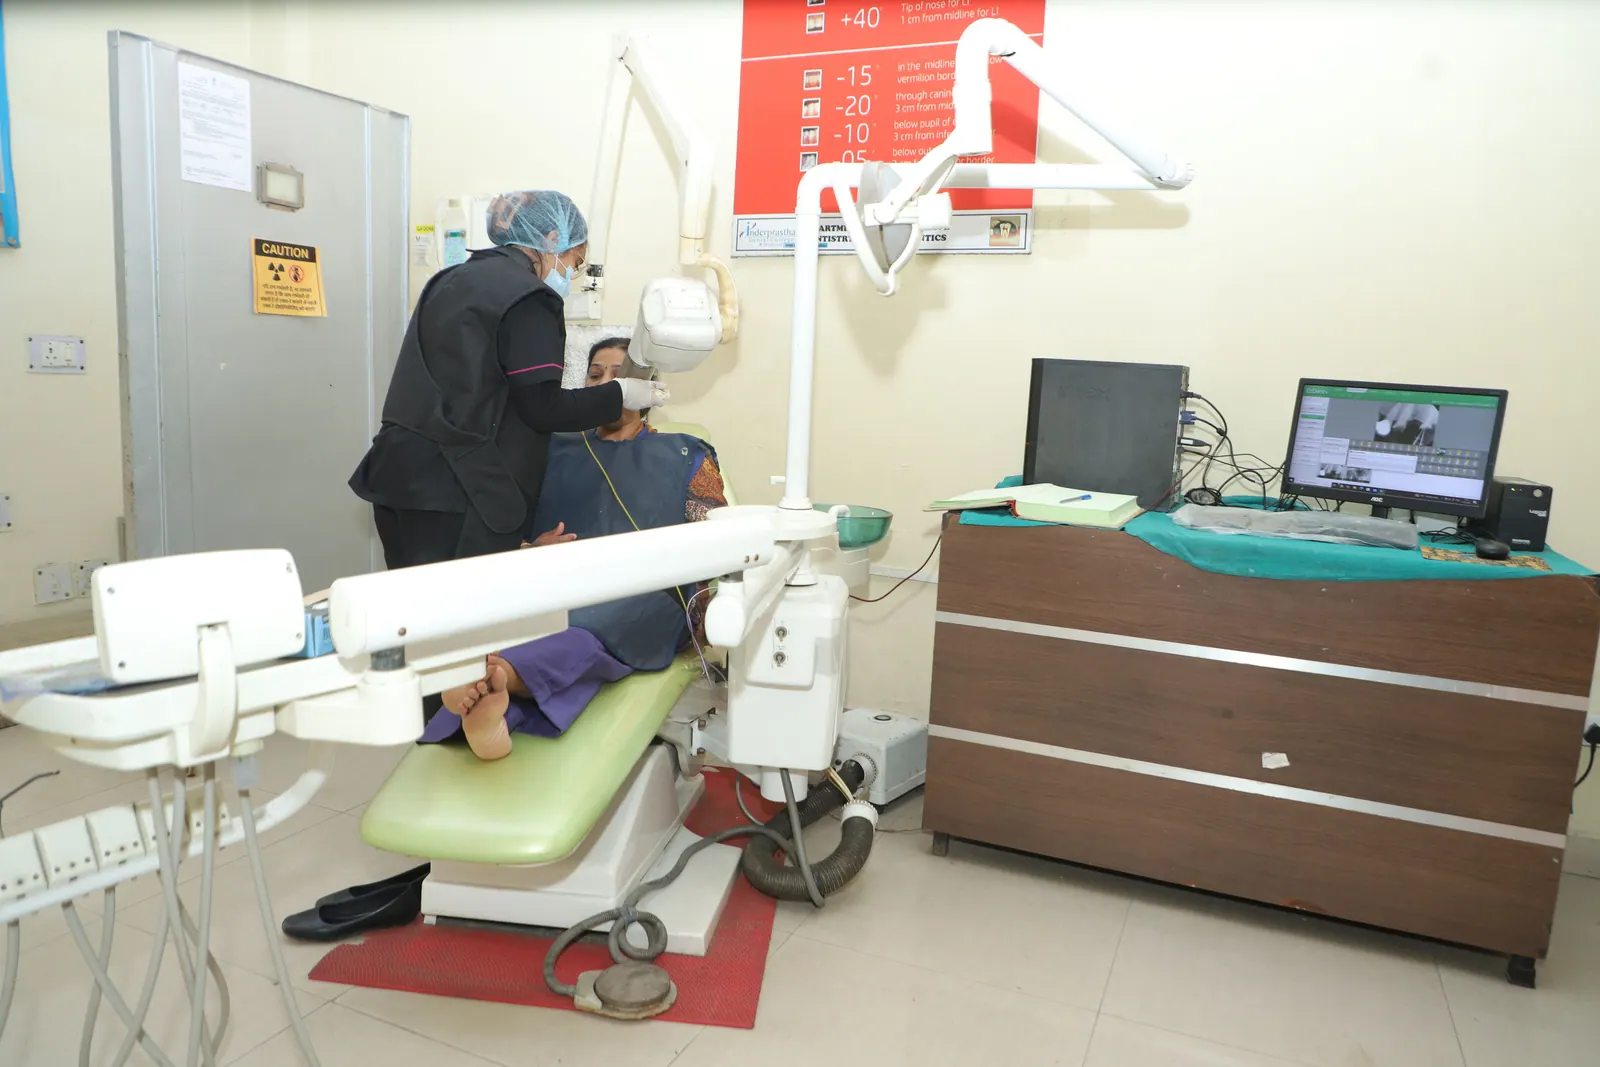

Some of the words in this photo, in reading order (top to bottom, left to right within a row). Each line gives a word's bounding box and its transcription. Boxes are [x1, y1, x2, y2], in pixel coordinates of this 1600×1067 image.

[901, 3, 913, 13] Tip
[915, 1, 924, 11] of
[926, 1, 945, 10] nose
[901, 16, 905, 24] 1
[908, 15, 920, 24] cm
[922, 13, 942, 23] from
[944, 9, 975, 20] midline
[977, 7, 989, 17] for
[897, 62, 905, 72] in
[907, 62, 921, 71] the
[924, 59, 956, 69] midline
[896, 72, 935, 84] vermilion
[895, 90, 928, 102] through
[929, 88, 953, 99] canin
[895, 103, 900, 113] 3
[902, 104, 915, 113] cm
[916, 102, 937, 112] from
[893, 119, 918, 130] below
[920, 117, 940, 129] pupil
[942, 117, 951, 126] of
[894, 132, 899, 141] 3
[901, 132, 913, 141] cm
[915, 130, 935, 140] from
[892, 146, 917, 157] below
[261, 243, 310, 260] CAUTION
